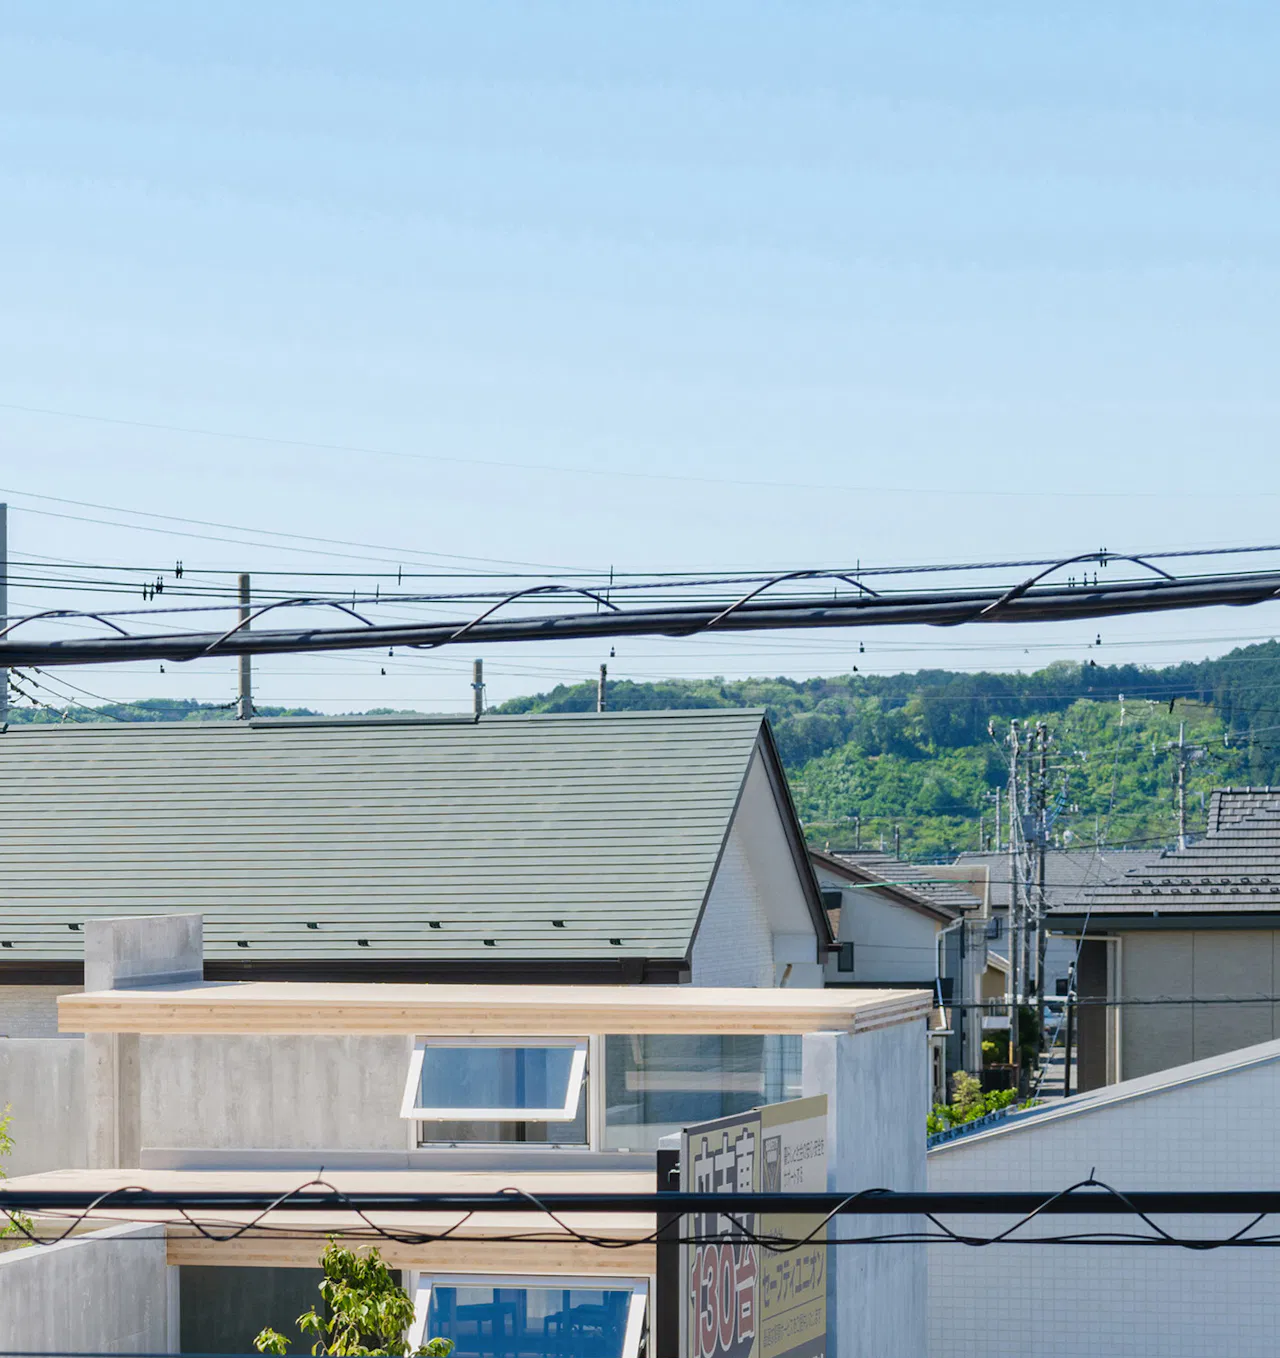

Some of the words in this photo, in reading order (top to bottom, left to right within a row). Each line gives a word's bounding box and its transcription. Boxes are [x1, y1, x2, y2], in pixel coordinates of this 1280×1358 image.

[762, 1248, 825, 1309] セーフティユニオン
